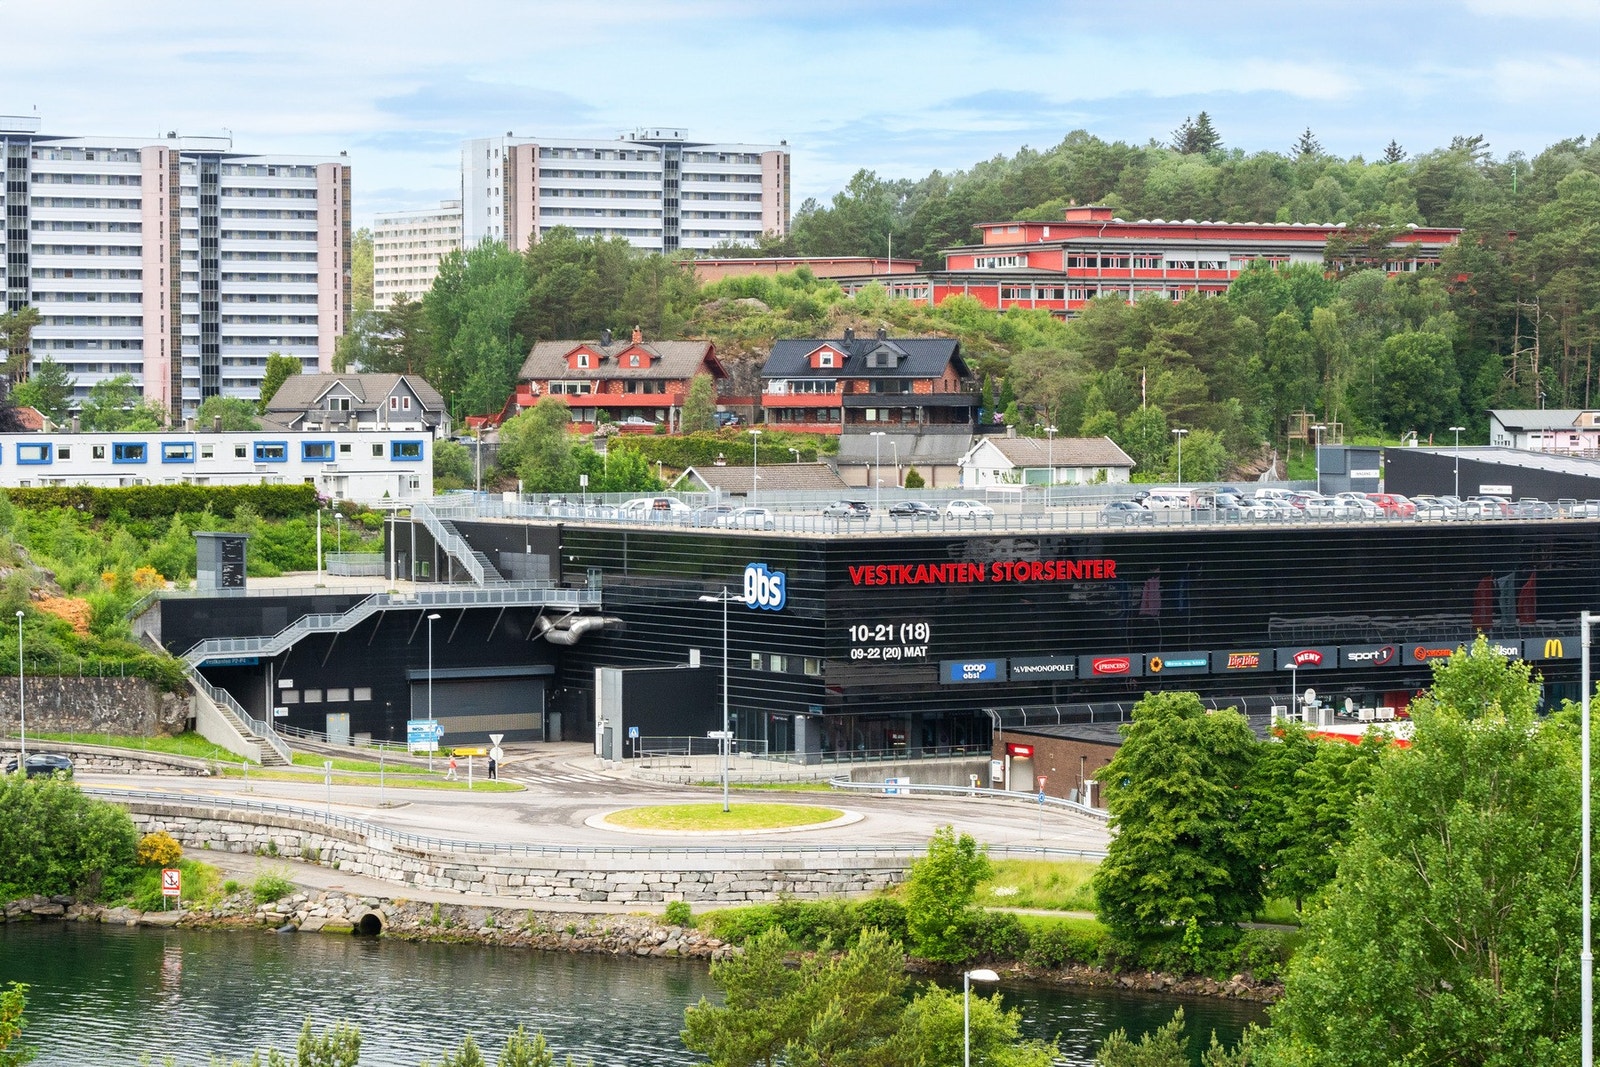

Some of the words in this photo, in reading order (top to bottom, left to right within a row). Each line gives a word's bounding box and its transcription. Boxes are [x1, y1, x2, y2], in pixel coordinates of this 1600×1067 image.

[849, 563, 985, 585] VESTKANTEN
[991, 559, 1117, 583] STORSENTER
[849, 624, 894, 642] 10-21
[900, 622, 930, 644] (18)
[851, 648, 880, 659] 09-22
[883, 646, 901, 660] (20)
[904, 646, 928, 657] MAT
[1297, 653, 1320, 663] MENY
[1348, 650, 1380, 661] sport
[1382, 650, 1387, 659] 1
[1099, 662, 1126, 670] PRINCESS
[1228, 655, 1242, 668] Big
[1242, 655, 1259, 665] Bite
[963, 664, 986, 673] coop
[1020, 664, 1074, 673] VINMONOPOLET
